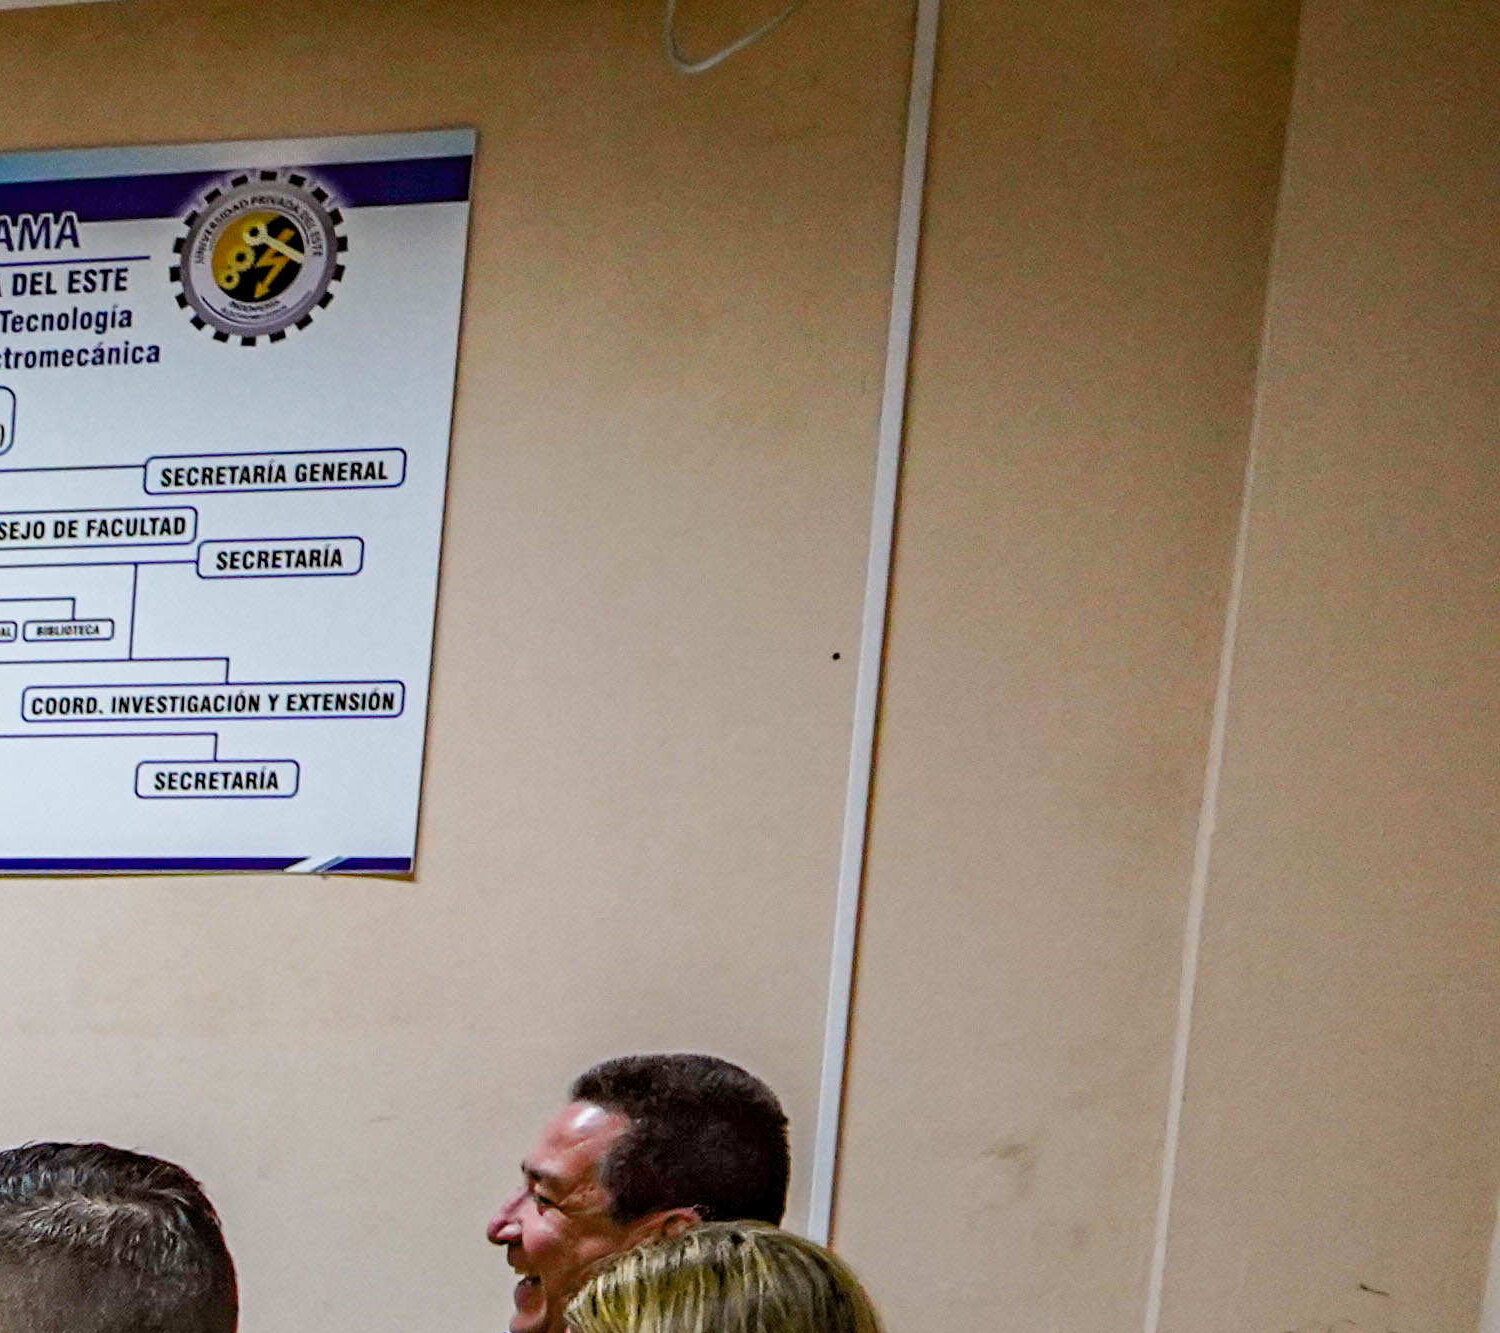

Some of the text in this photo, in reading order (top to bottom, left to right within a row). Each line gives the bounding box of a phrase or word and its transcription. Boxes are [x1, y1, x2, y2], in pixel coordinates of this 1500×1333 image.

[11, 271, 58, 298] DEL
[66, 267, 130, 294] ESTE
[160, 458, 389, 487] SECRETARÍA GENERAL
[53, 519, 79, 540] DE
[86, 516, 187, 538] FACULTAD
[216, 545, 344, 571] SECRETARÍA
[31, 687, 396, 716] COORD. INVESTIGACIÓN Y EXTENSIÓN
[153, 766, 279, 791] SECRETARÍA
